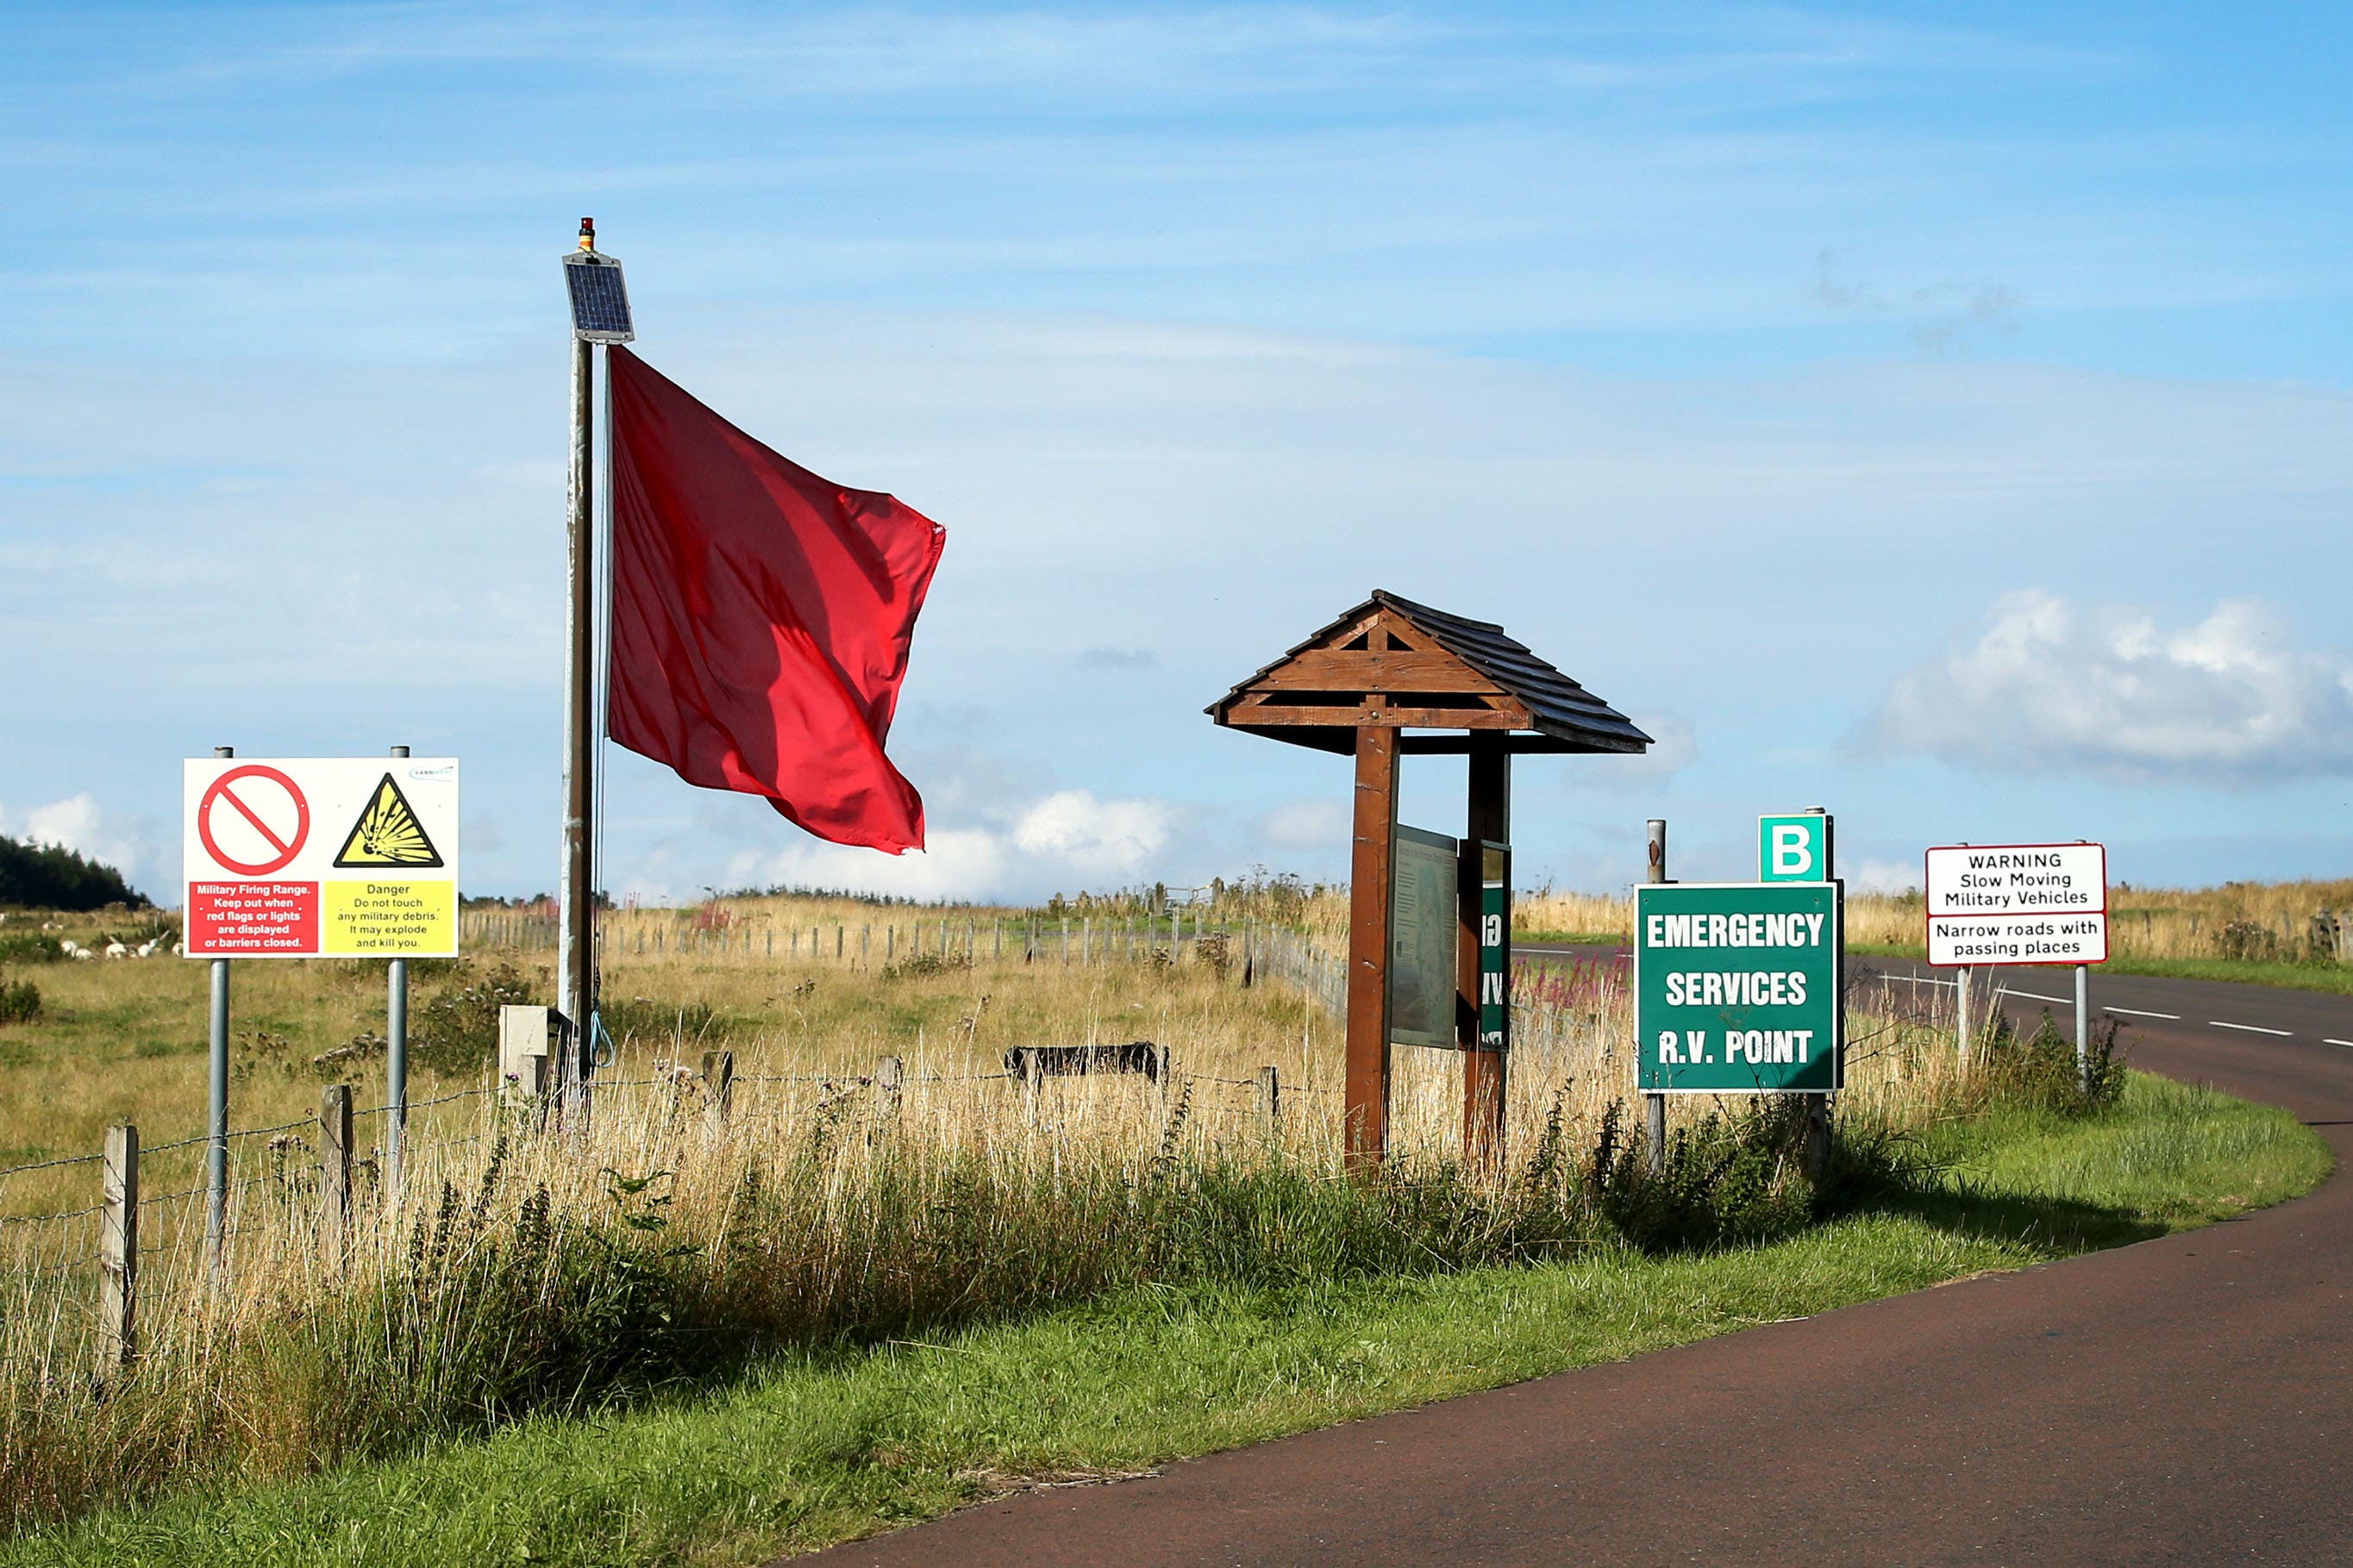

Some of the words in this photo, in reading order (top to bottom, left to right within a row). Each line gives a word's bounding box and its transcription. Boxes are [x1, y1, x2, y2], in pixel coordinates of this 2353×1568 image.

[1772, 825, 1812, 875] B
[1968, 853, 2062, 869] WARNING
[1961, 874, 2002, 888] Slow
[2011, 872, 2071, 888] Moving
[197, 884, 236, 896] Military
[239, 884, 270, 896] Firing
[273, 884, 310, 896] Range.
[367, 884, 410, 896] Danger
[214, 898, 241, 909] Keep
[244, 899, 262, 908] out
[264, 898, 293, 908] when
[354, 898, 369, 908] Do
[372, 899, 390, 908] not
[392, 898, 422, 908] touch
[1945, 893, 2011, 908] Military
[2018, 890, 2088, 904] Vehicles
[207, 911, 224, 921] red
[228, 911, 253, 922] flags
[270, 911, 301, 922] lights
[338, 913, 356, 922] any
[360, 912, 399, 922] military
[403, 912, 439, 921] debris.
[238, 924, 290, 936] displayed
[350, 925, 356, 934] It
[360, 927, 382, 936] may
[385, 925, 427, 935] explode
[1647, 913, 1825, 948] EMERGENCY
[1937, 924, 1999, 938] Narrow
[2007, 922, 2054, 936] roads
[2061, 921, 2098, 934] with
[204, 939, 216, 947] or
[219, 938, 260, 947] barriers
[264, 938, 303, 947] closed.
[356, 939, 376, 947] and
[379, 939, 395, 947] kill
[397, 940, 421, 949] you.
[1954, 941, 2018, 958] passing
[2025, 940, 2081, 957] places
[1666, 971, 1807, 1006] SERVICES
[1659, 1030, 1714, 1064] R.V.
[1725, 1030, 1813, 1065] POINT
